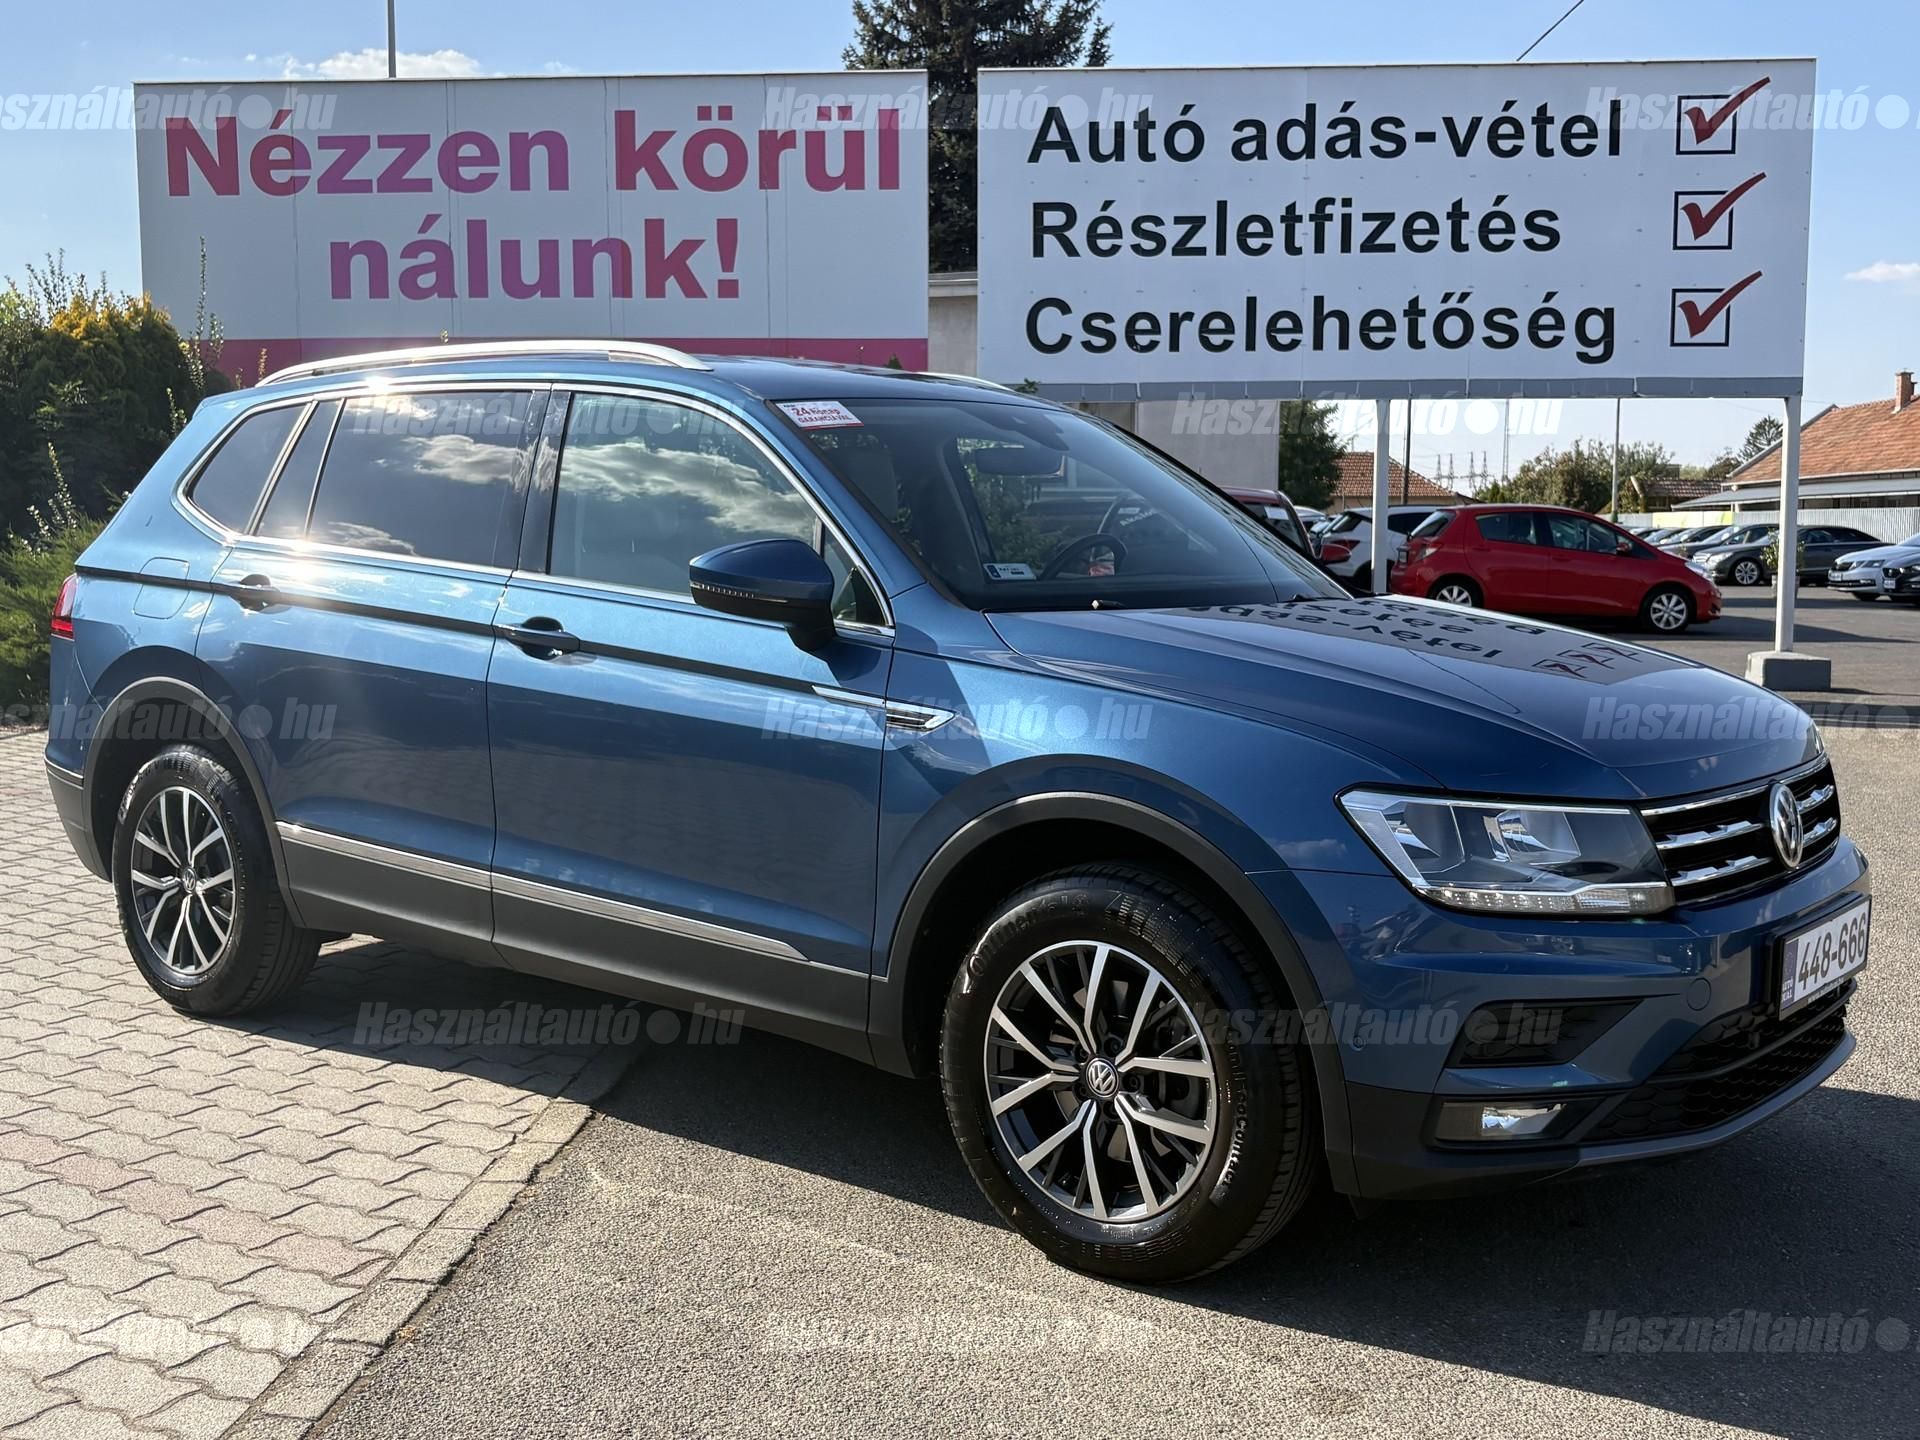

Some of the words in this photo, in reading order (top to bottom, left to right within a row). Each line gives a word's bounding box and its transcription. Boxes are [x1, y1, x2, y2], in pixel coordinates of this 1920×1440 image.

[165, 108, 570, 197] Nézzen
[615, 105, 900, 192] körül
[1027, 104, 1206, 163] Autó
[1231, 99, 1621, 162] adás-vétel
[330, 213, 740, 300] nálunk!
[1032, 194, 1561, 258] Részletfizetés
[1025, 290, 1615, 365] Cserelehetőség
[1799, 911, 1867, 990] 448-666
